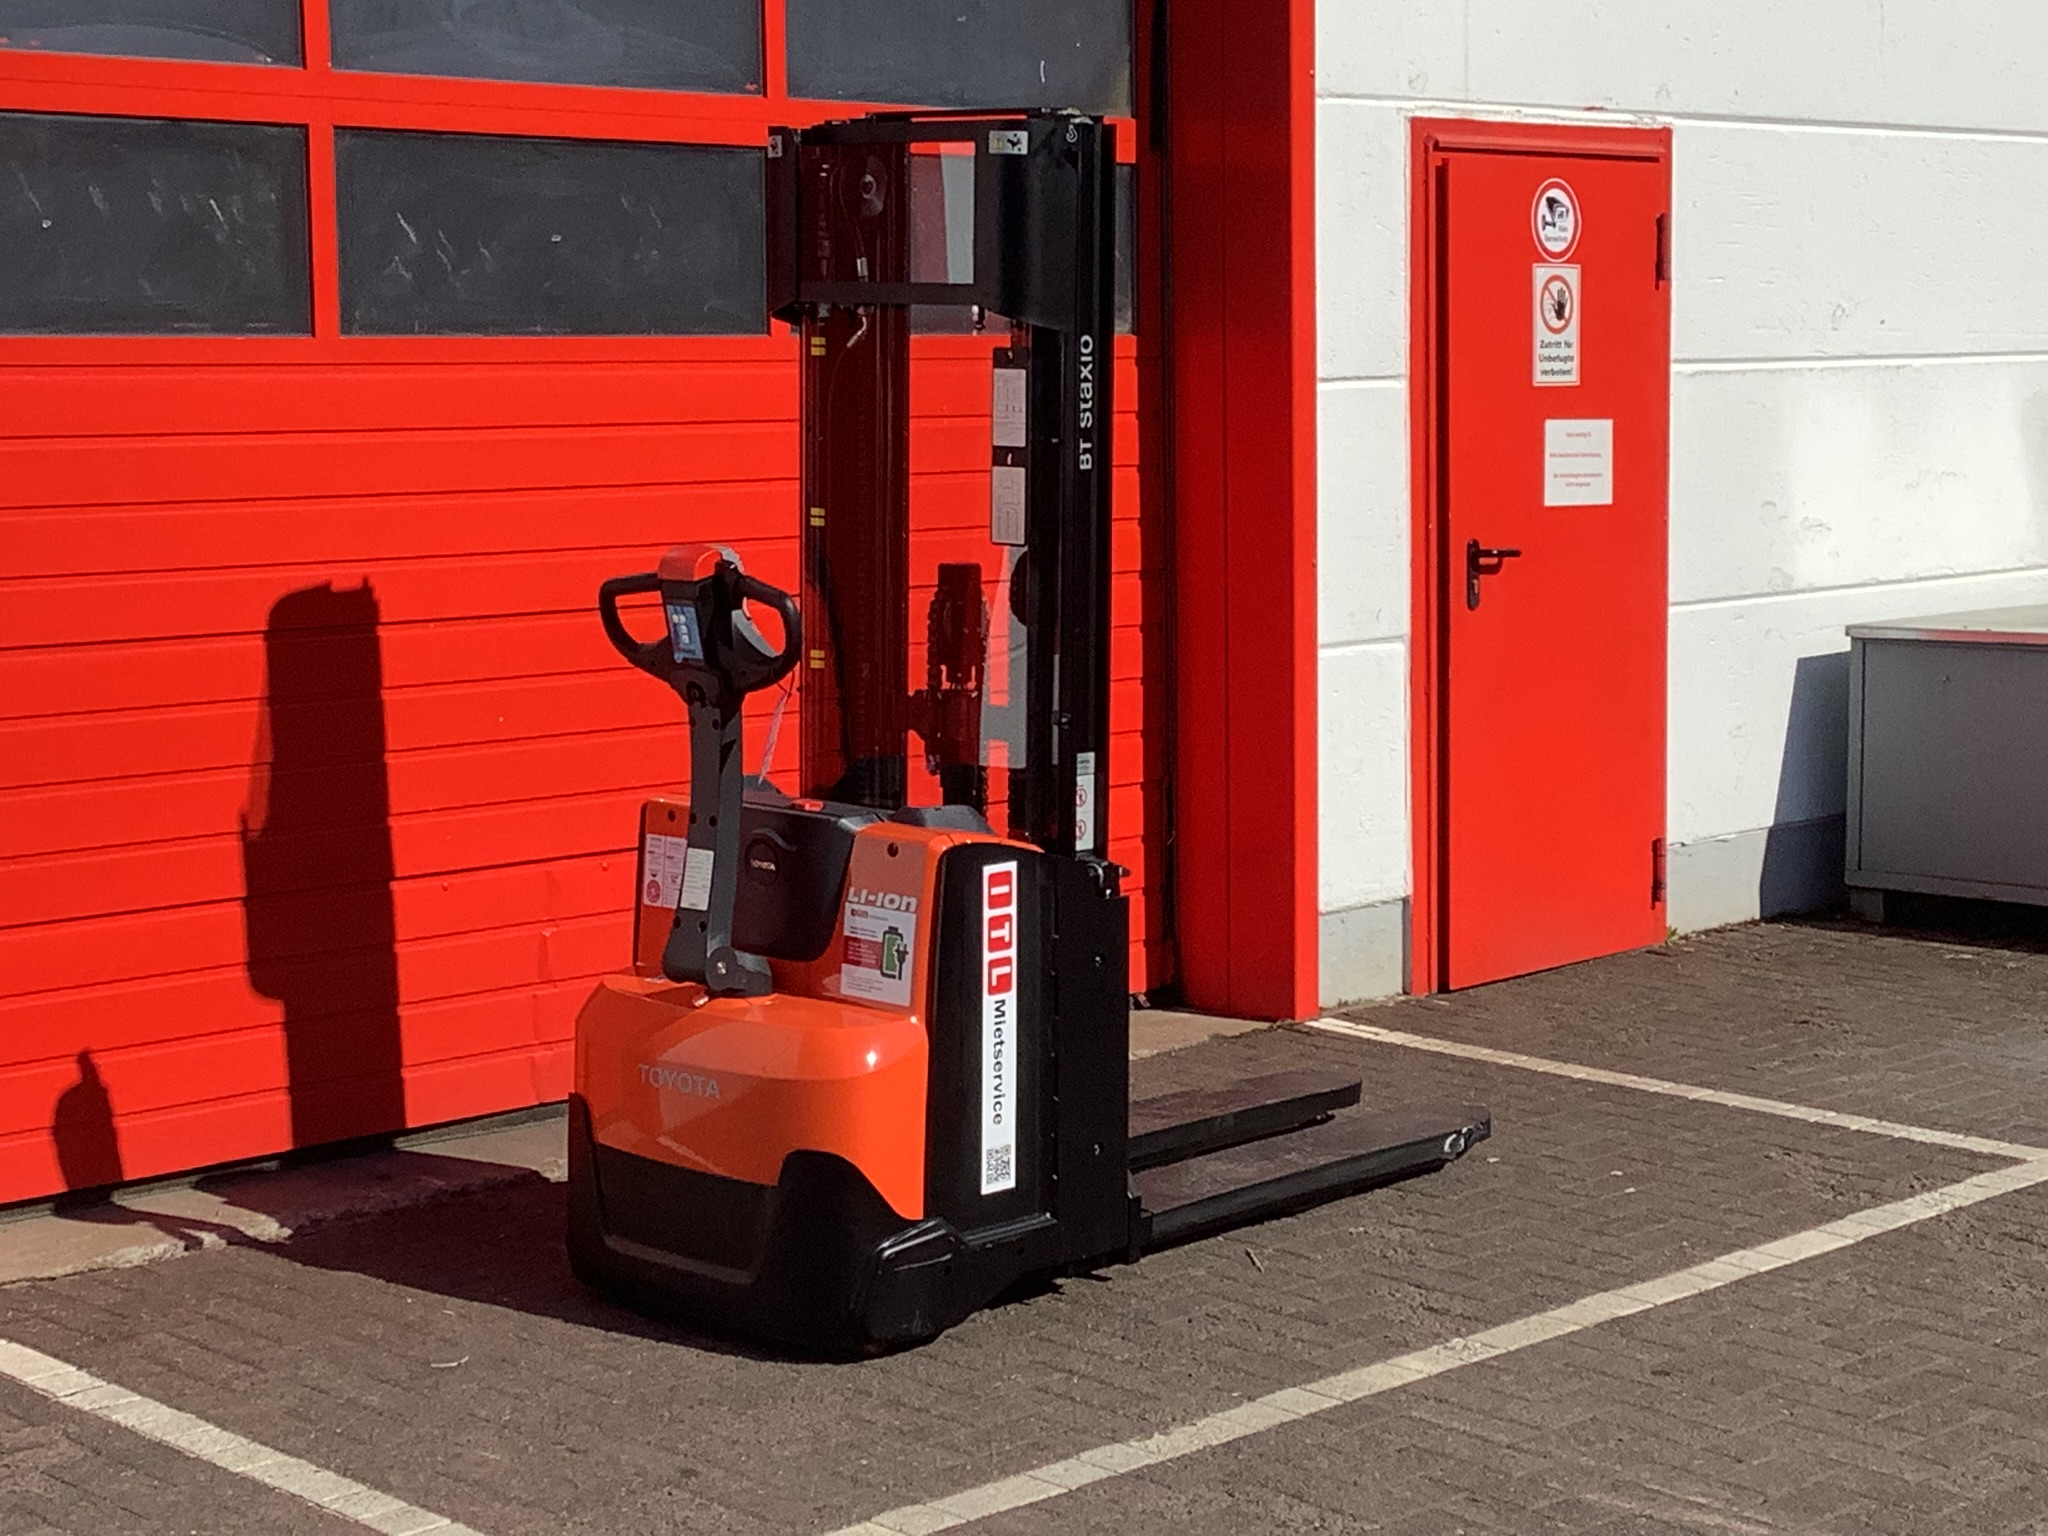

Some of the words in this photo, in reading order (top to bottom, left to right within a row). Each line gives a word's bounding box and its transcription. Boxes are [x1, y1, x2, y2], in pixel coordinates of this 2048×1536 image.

[1539, 339, 1562, 349] Zutritt
[1538, 353, 1575, 364] Unbefugte
[1540, 367, 1573, 377] verboten!
[1080, 438, 1092, 470] BT
[993, 998, 1006, 1125] Mietservice
[638, 1063, 721, 1099] TOYOTA
